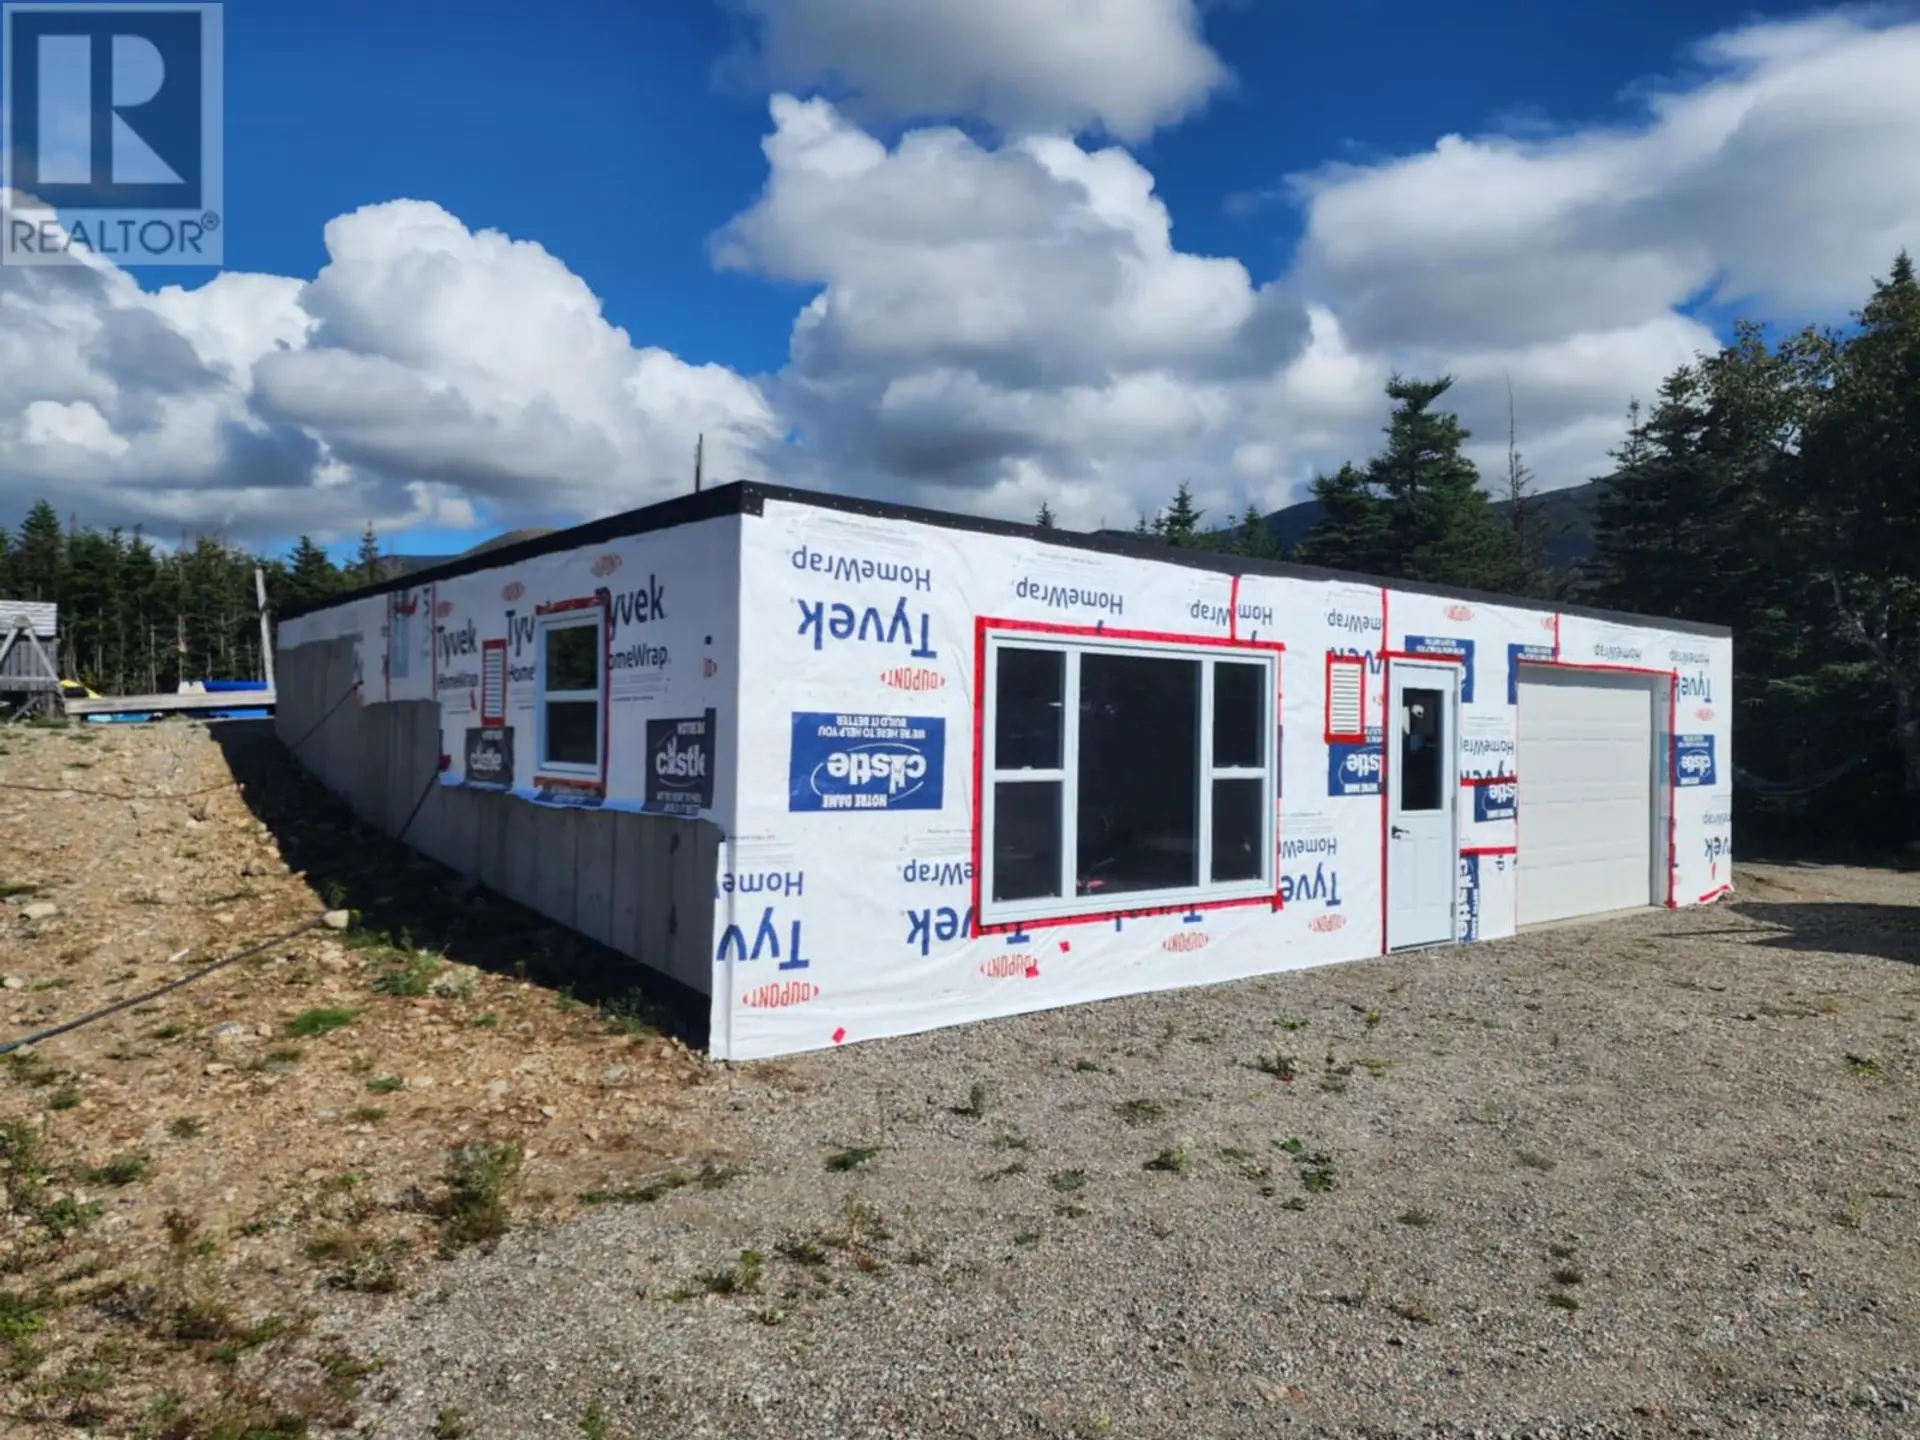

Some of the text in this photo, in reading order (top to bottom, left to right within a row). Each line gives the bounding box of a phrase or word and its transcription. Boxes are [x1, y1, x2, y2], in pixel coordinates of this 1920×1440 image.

[792, 545, 931, 592] HomeWrap
[1016, 577, 1123, 615] HomeWrap
[1191, 600, 1273, 625] HomWrap
[797, 597, 937, 659] Tyvek
[722, 871, 804, 897] Home
[716, 906, 809, 970] Tyv
